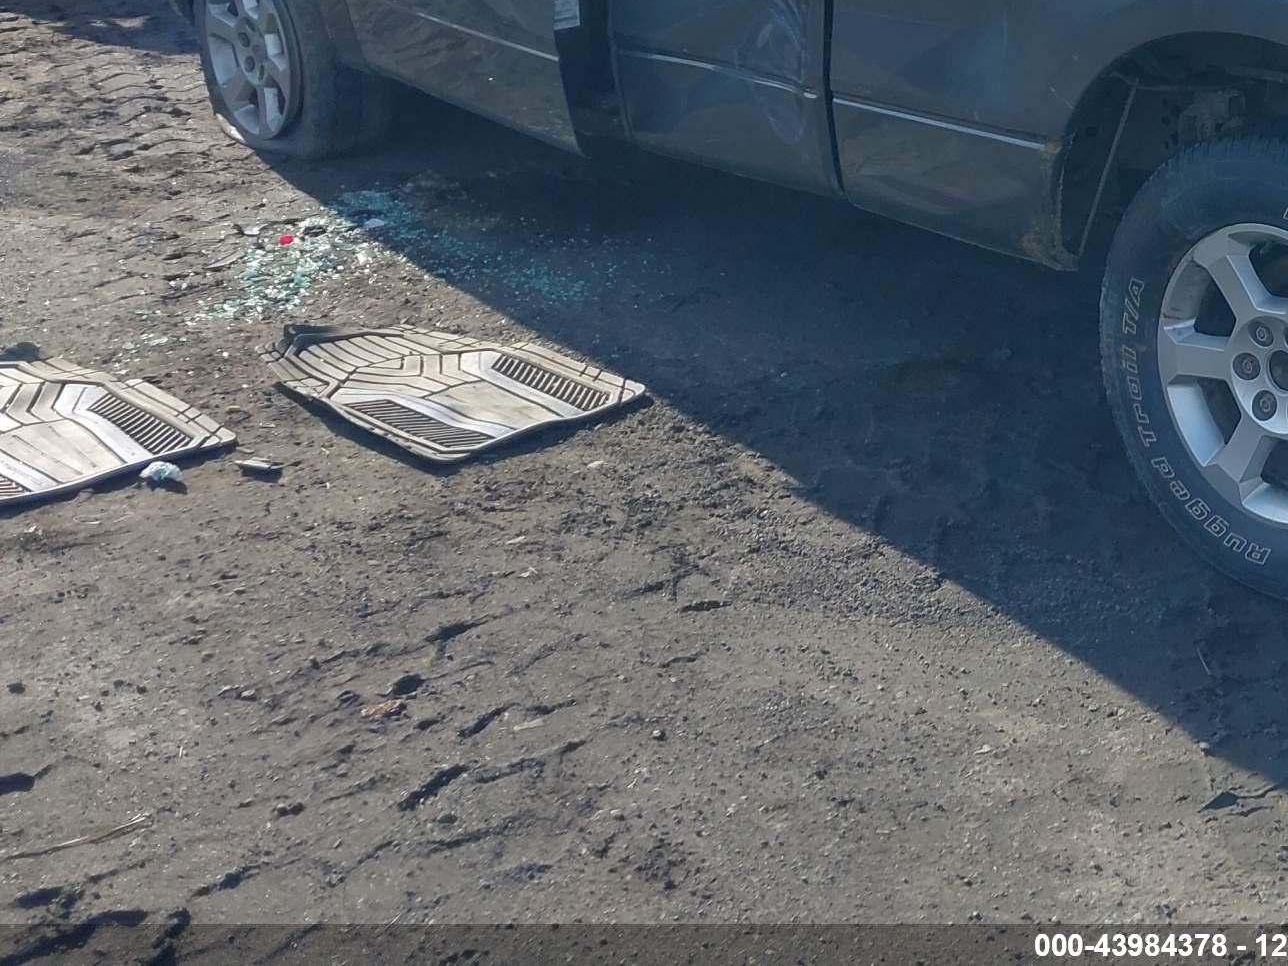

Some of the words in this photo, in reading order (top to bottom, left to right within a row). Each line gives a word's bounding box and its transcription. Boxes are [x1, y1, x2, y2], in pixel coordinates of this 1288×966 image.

[1122, 277, 1145, 336] T/A
[1121, 344, 1157, 448] Trail
[1151, 456, 1272, 565] Rugged
